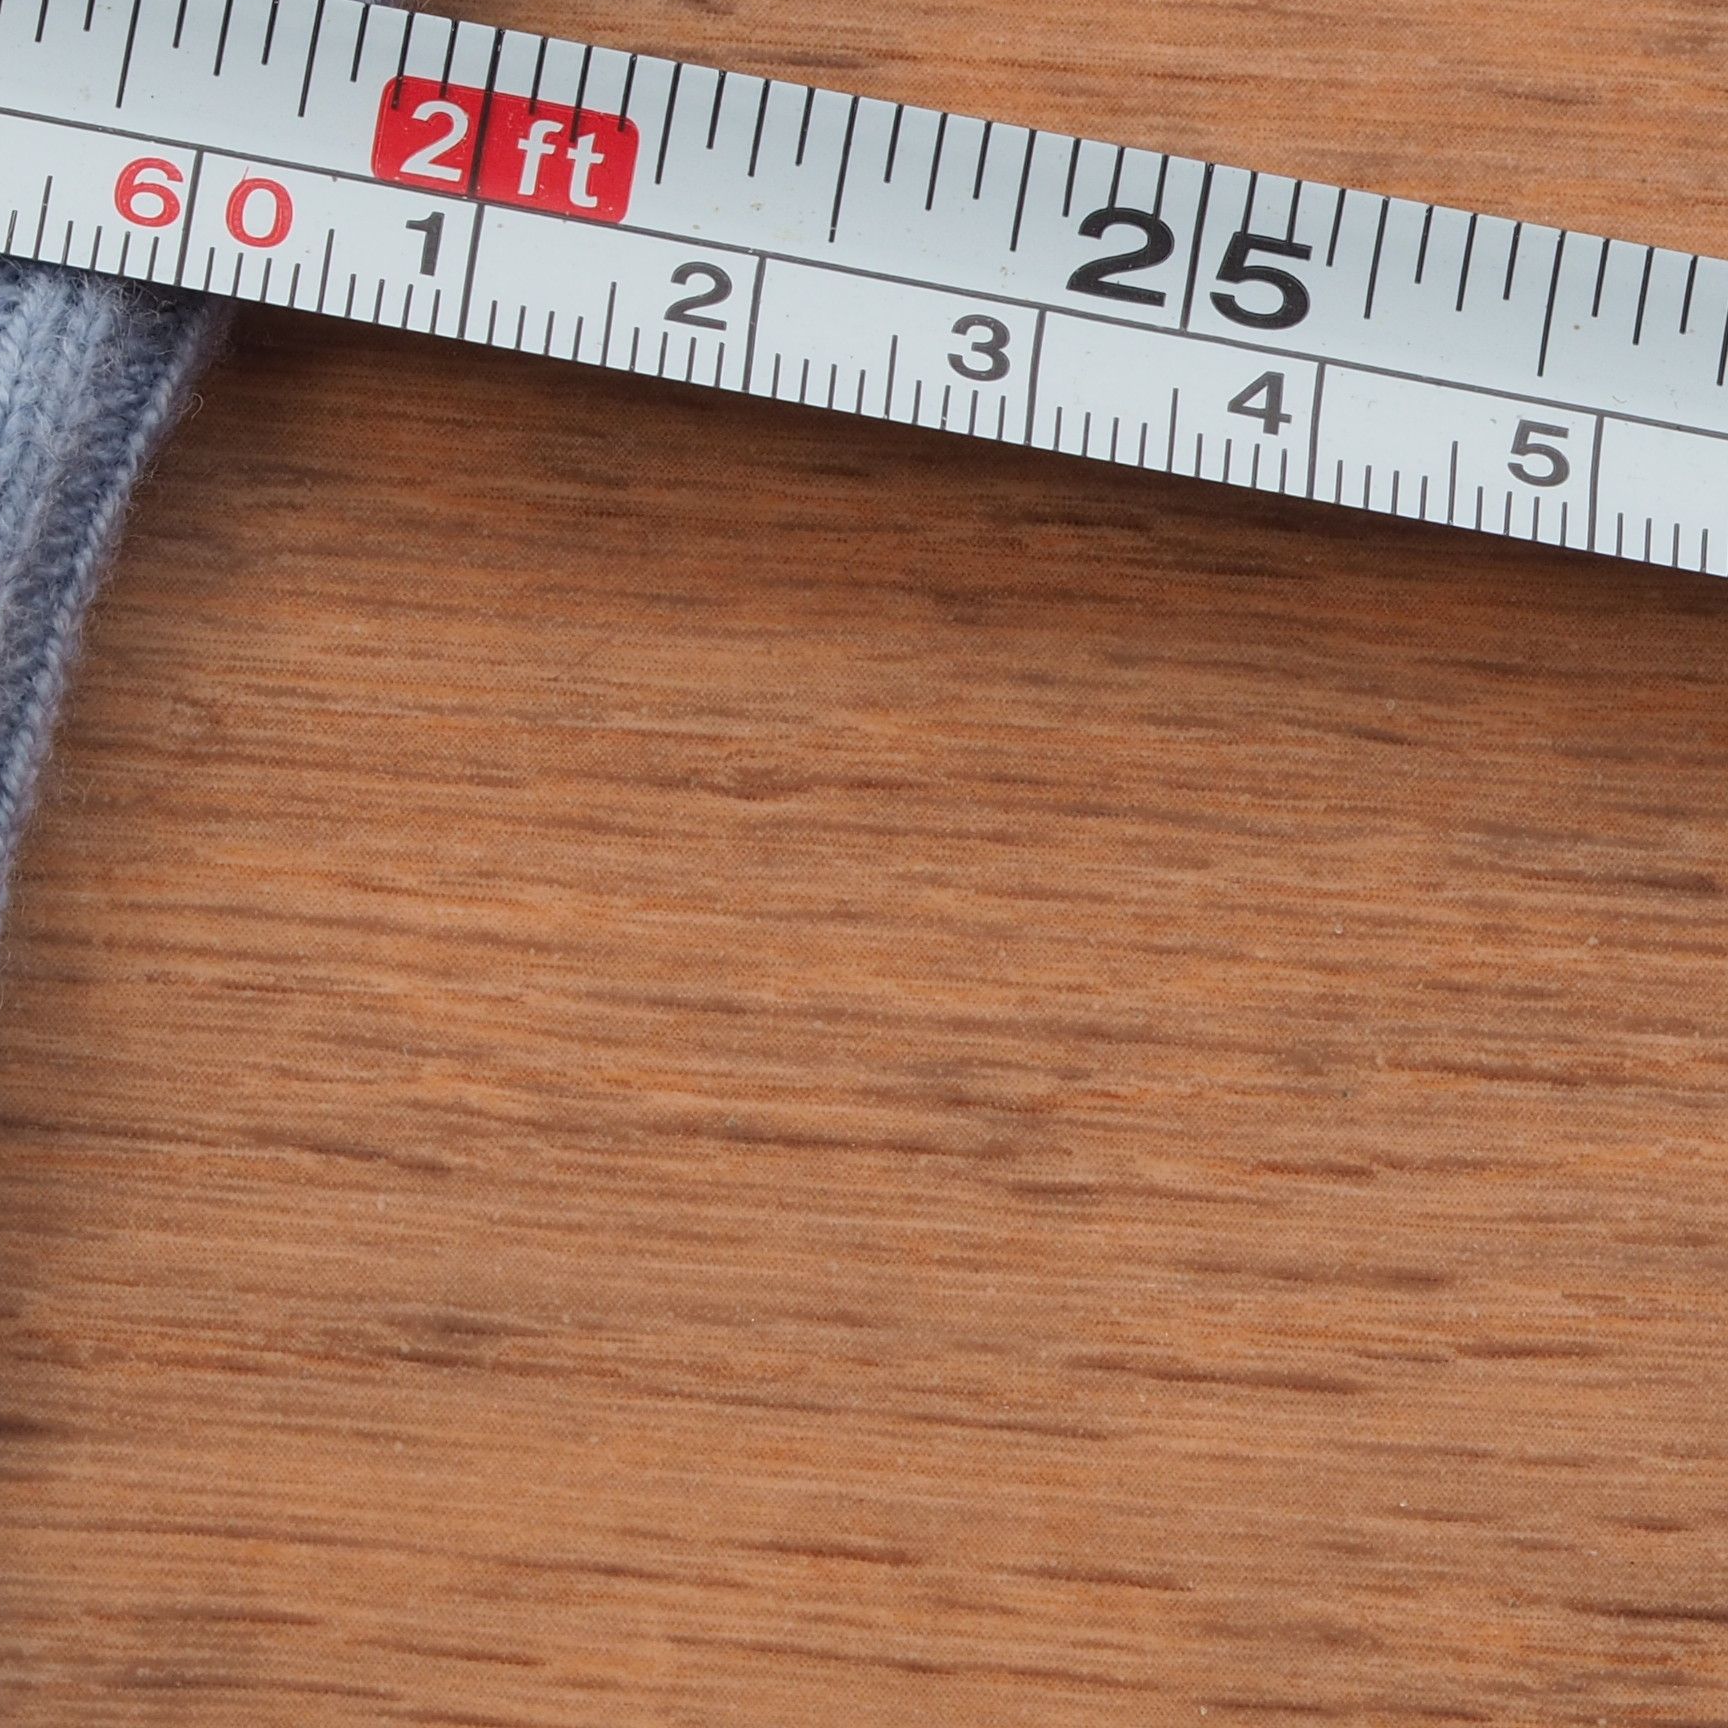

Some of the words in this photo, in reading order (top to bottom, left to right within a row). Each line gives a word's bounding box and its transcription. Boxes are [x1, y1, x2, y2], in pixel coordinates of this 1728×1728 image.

[114, 156, 294, 248] 60
[405, 211, 445, 276] 1
[664, 262, 733, 332] 2
[946, 314, 1011, 382] 3
[1227, 371, 1292, 435] 4
[1507, 419, 1571, 487] 5
[399, 100, 470, 183] 2
[516, 120, 605, 209] ft
[1066, 207, 1313, 330] 25
